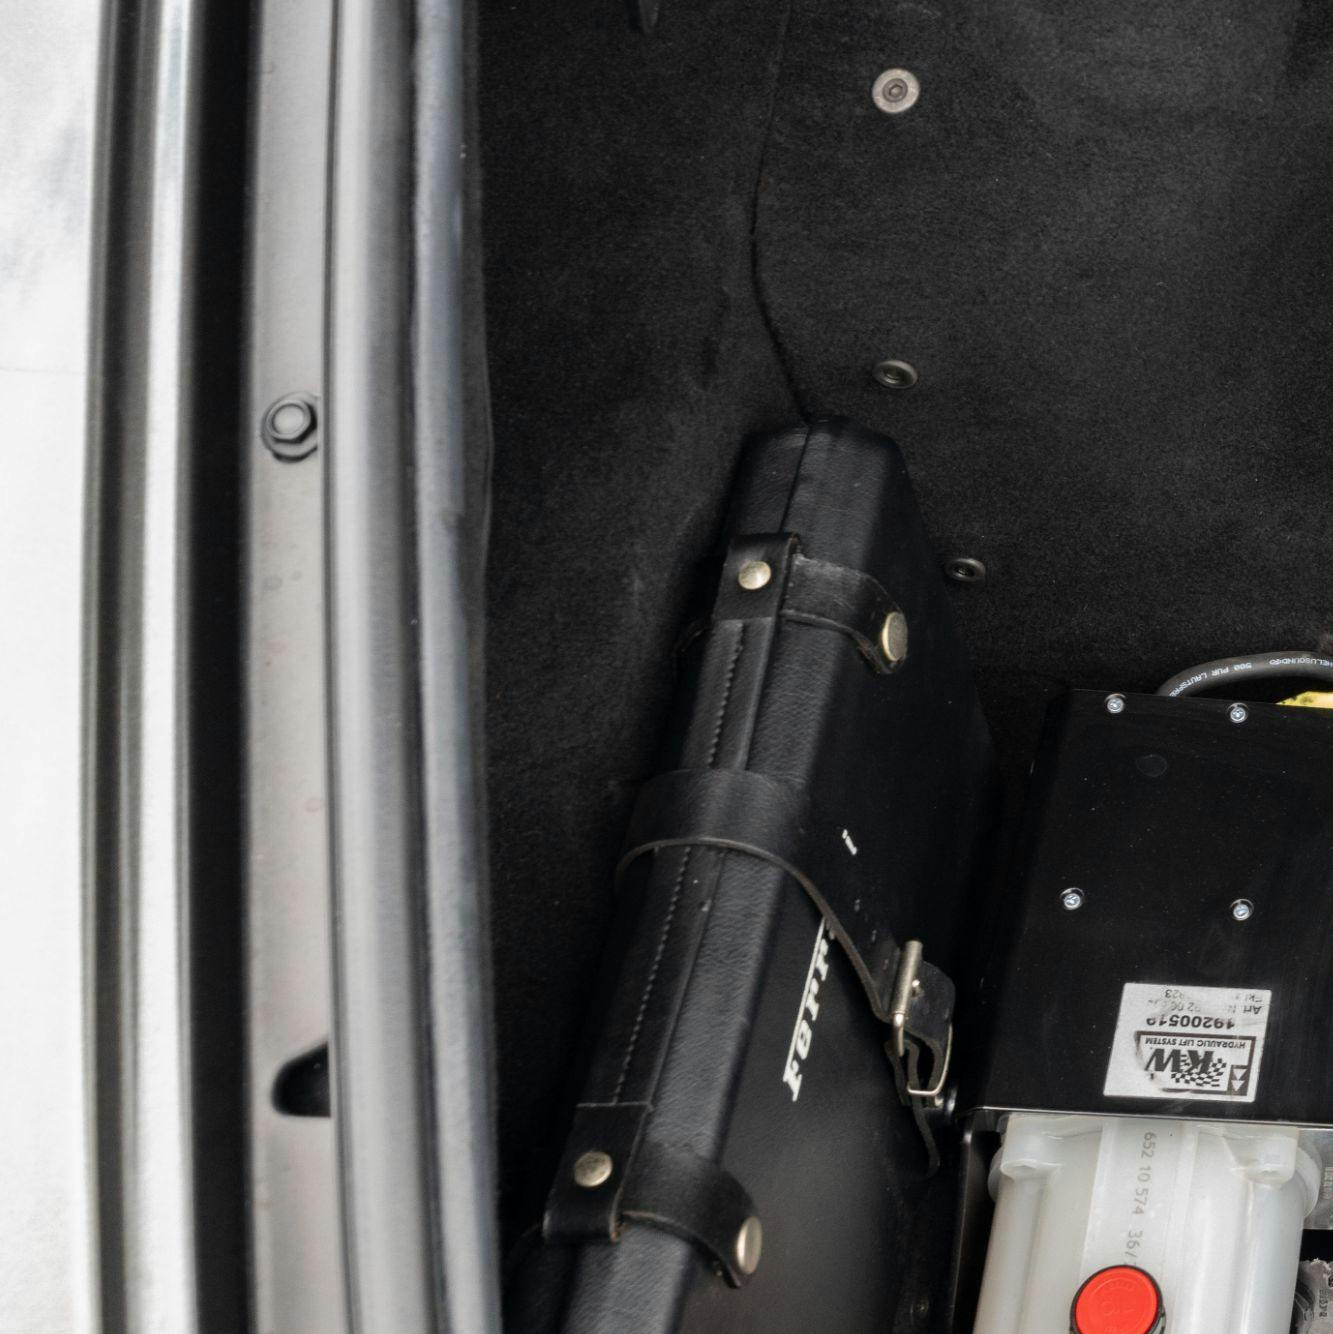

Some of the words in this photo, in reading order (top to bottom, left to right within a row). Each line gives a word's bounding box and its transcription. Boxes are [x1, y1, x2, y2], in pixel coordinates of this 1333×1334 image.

[1211, 666, 1229, 677] PUR
[1145, 1037, 1177, 1045] SYSTEM
[1197, 1040, 1246, 1049] HYDRAULIC
[1144, 1048, 1214, 1073] KW
[1141, 1131, 1157, 1158] 652
[1137, 1166, 1151, 1182] 10
[1132, 1188, 1149, 1214] 574
